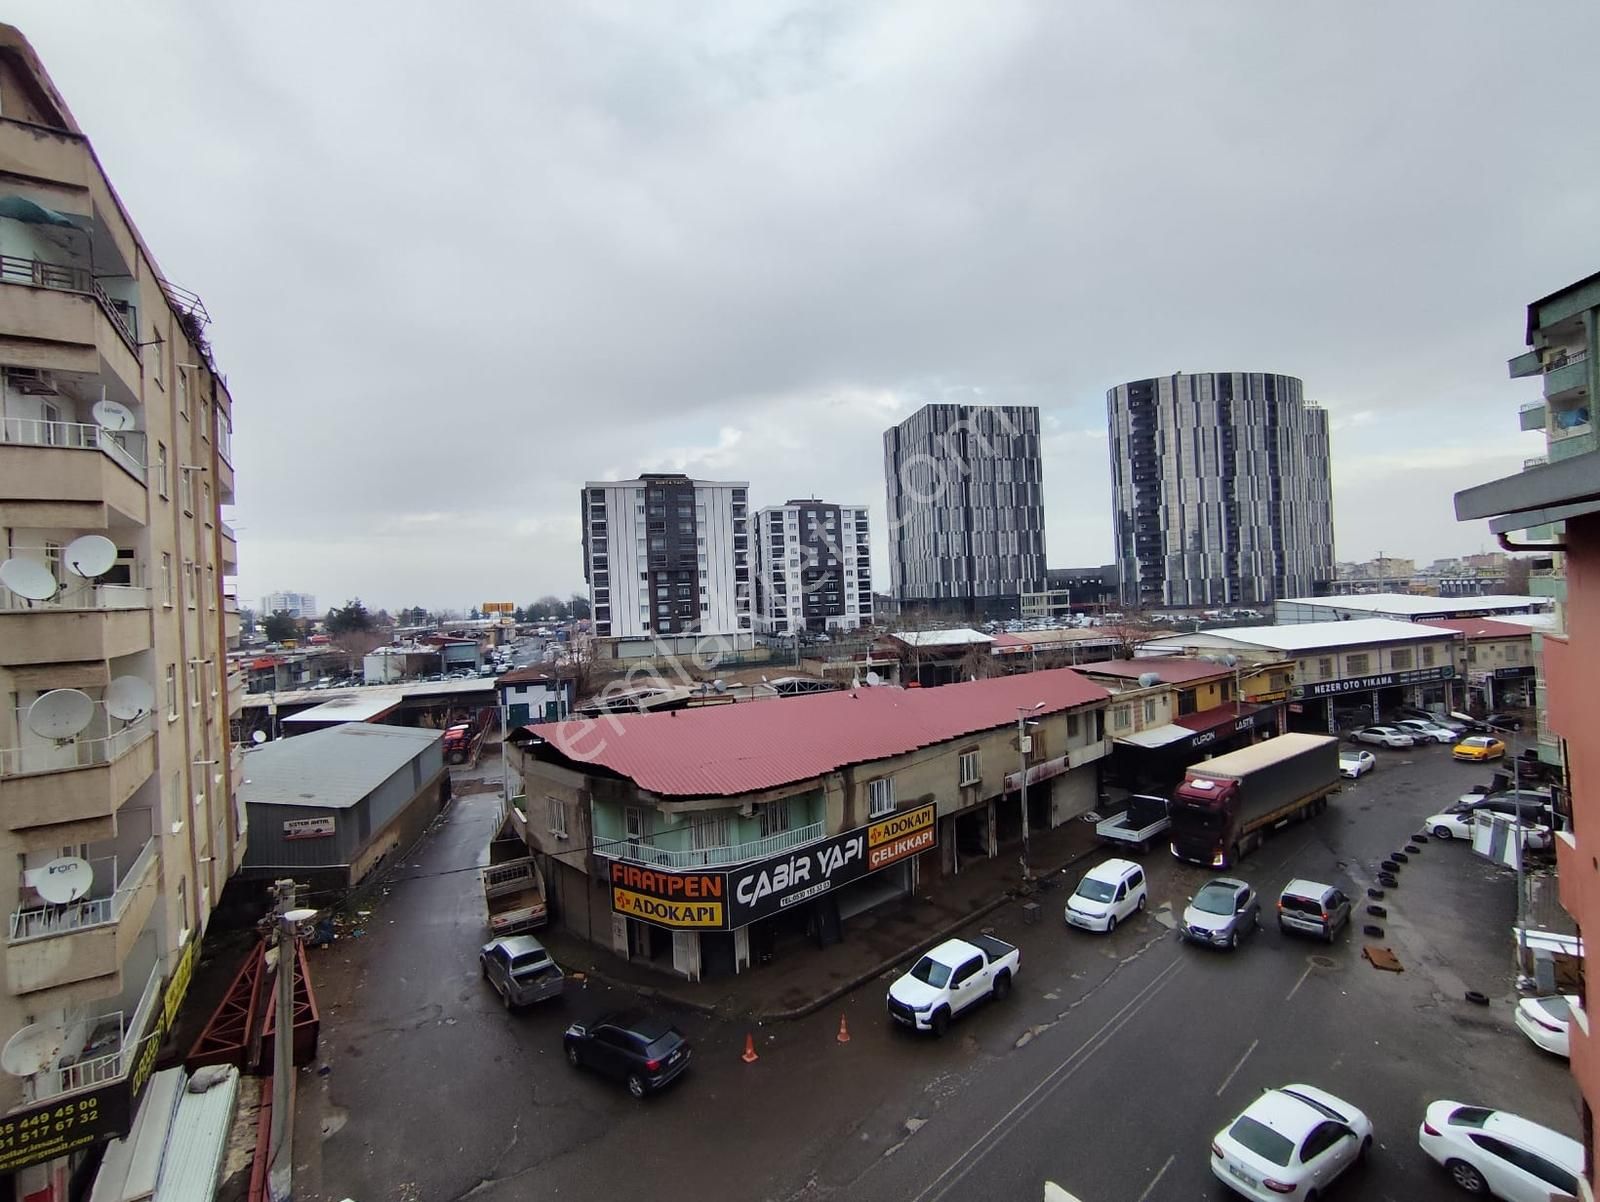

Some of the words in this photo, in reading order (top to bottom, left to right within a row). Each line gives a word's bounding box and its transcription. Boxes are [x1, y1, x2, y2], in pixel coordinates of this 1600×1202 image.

[1343, 680, 1360, 690] OTO
[1362, 676, 1393, 688] YIKAMA
[882, 809, 932, 838] ADOKAPI
[871, 830, 934, 865] ÇELİKKAPI
[612, 862, 722, 897] FIRATPEN
[736, 856, 811, 907] CABİR
[817, 836, 864, 878] YAPI
[632, 896, 716, 922] ADOKAPI
[20, 1112, 50, 1129] 449
[54, 1104, 75, 1118] 45
[79, 1097, 97, 1111] 00
[20, 1125, 50, 1143] 517
[55, 1117, 75, 1131] 67
[79, 1110, 98, 1124] 32
